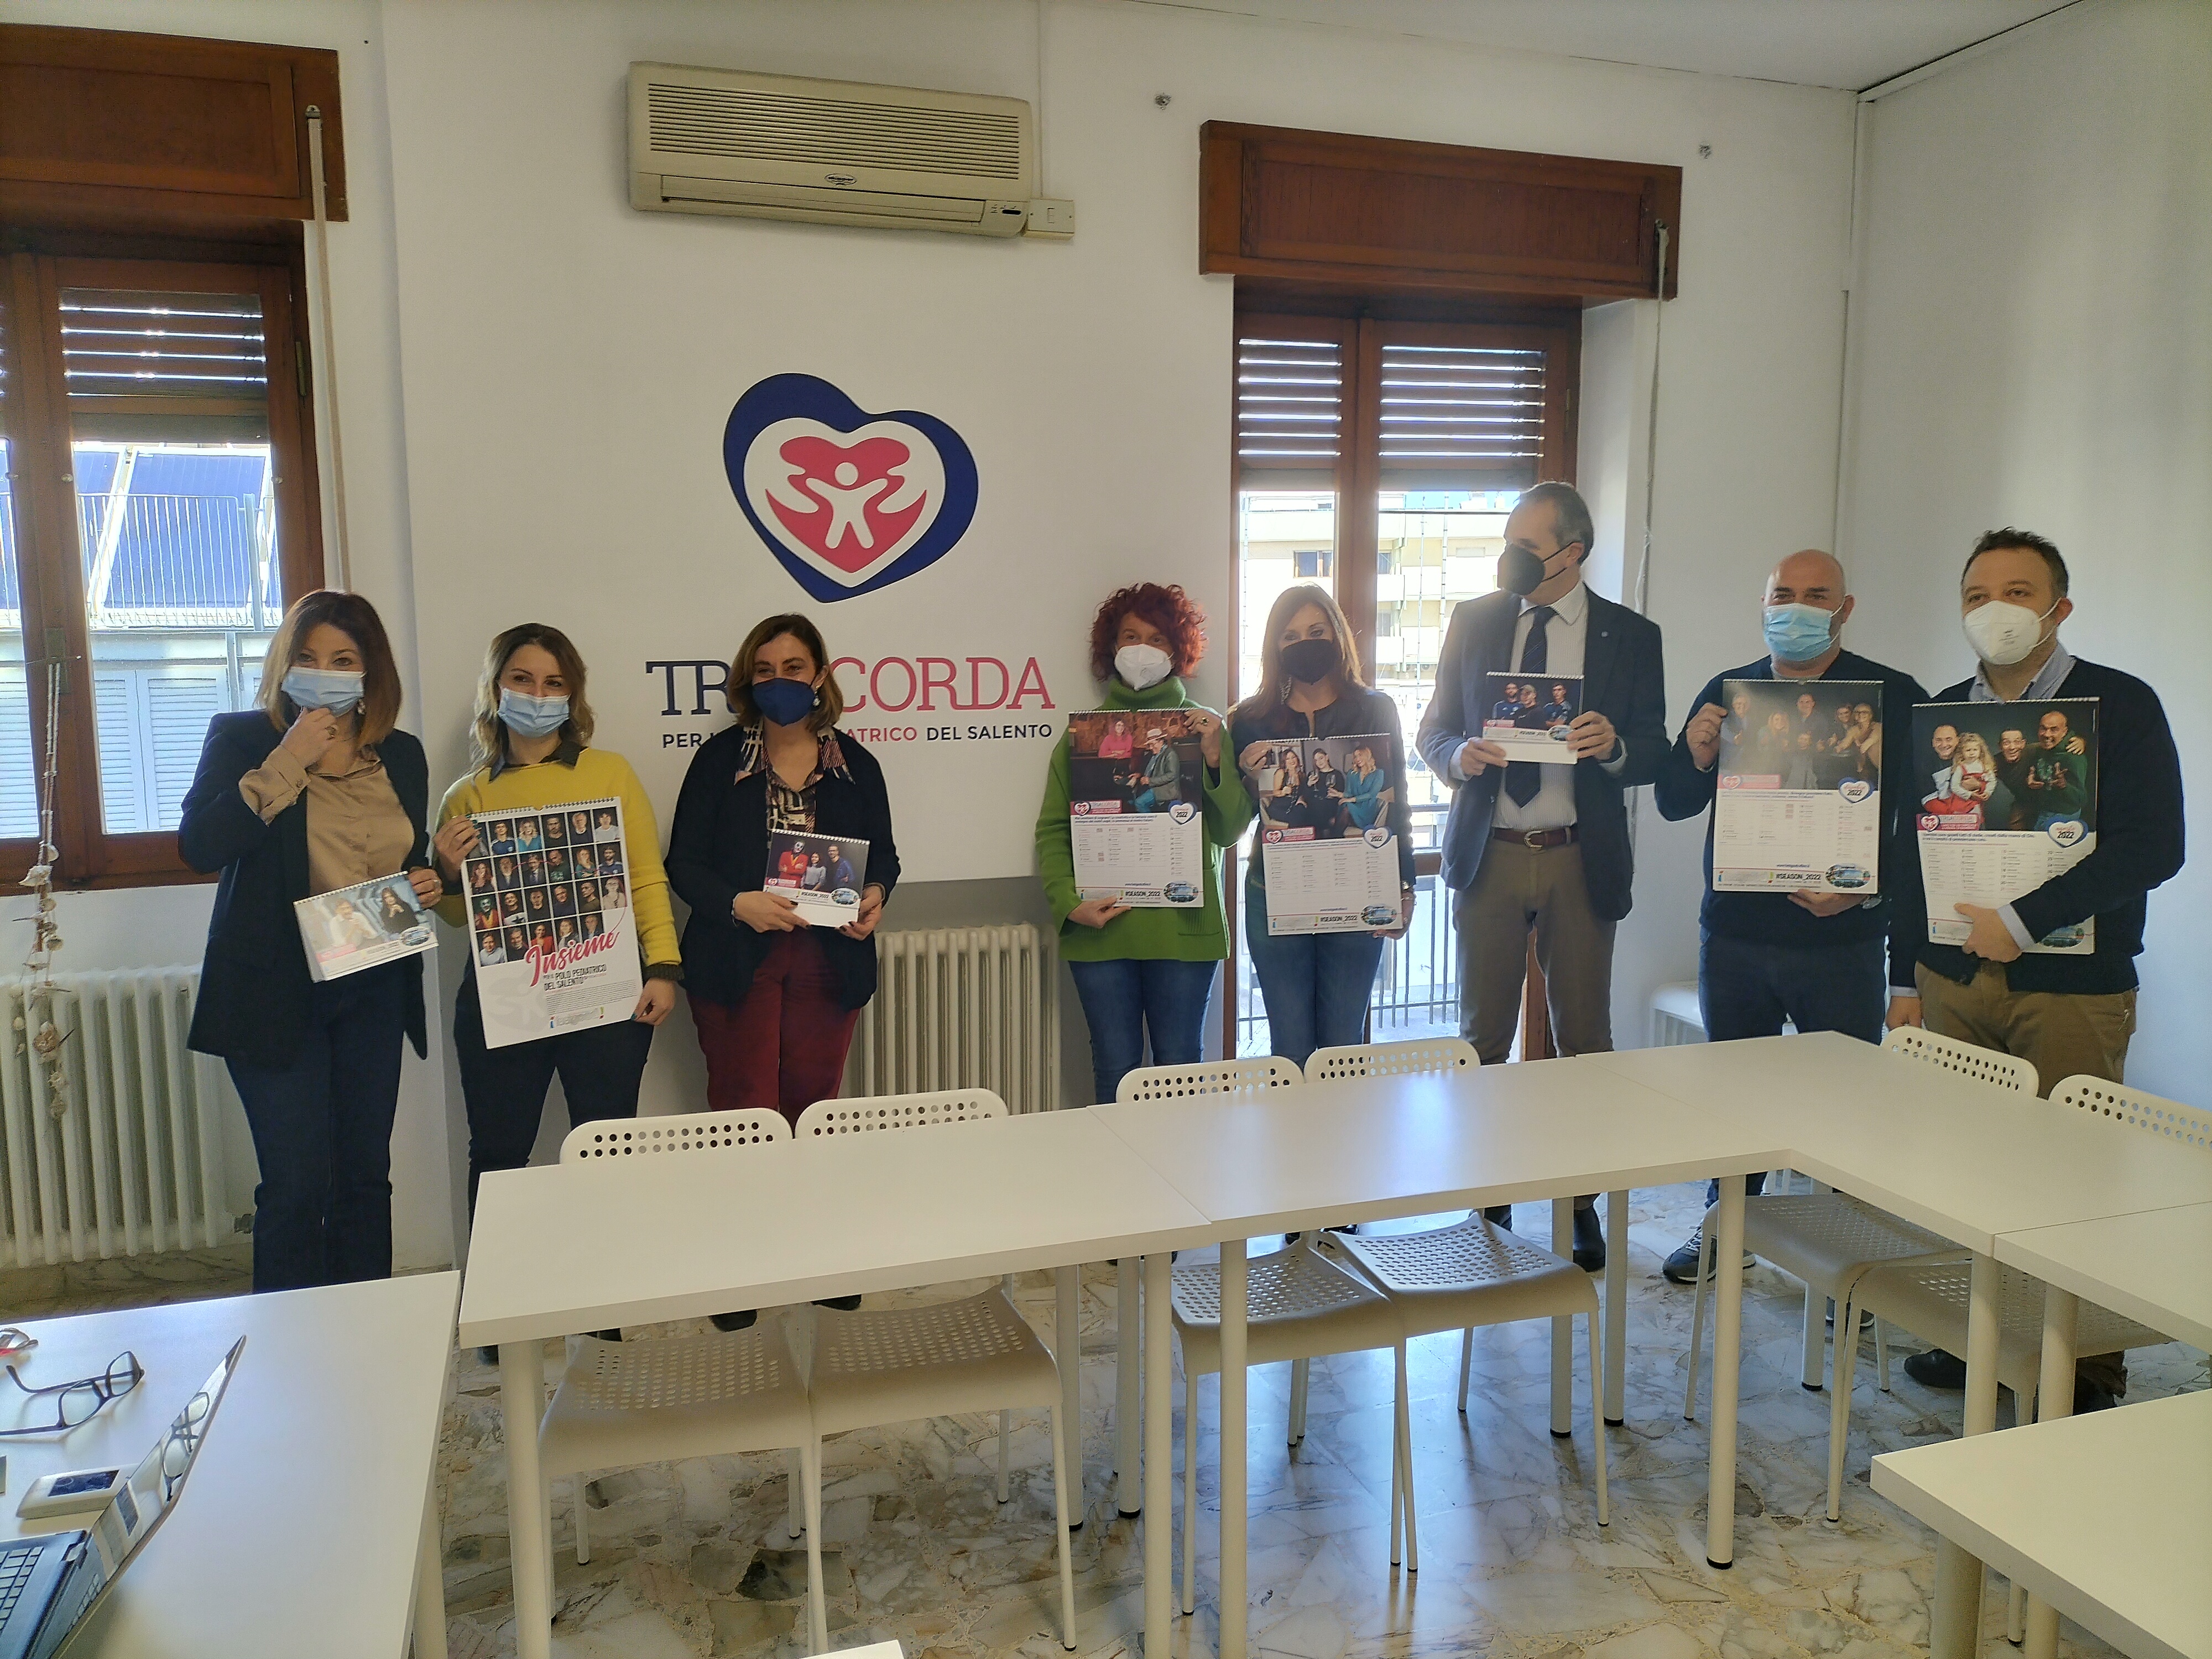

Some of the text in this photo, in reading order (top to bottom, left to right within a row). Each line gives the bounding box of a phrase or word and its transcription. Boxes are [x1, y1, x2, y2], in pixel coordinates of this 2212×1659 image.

[645, 660, 742, 716] TR
[662, 724, 1052, 748] PER ATRICO DEL SALENTO
[526, 931, 620, 987] Insieme
